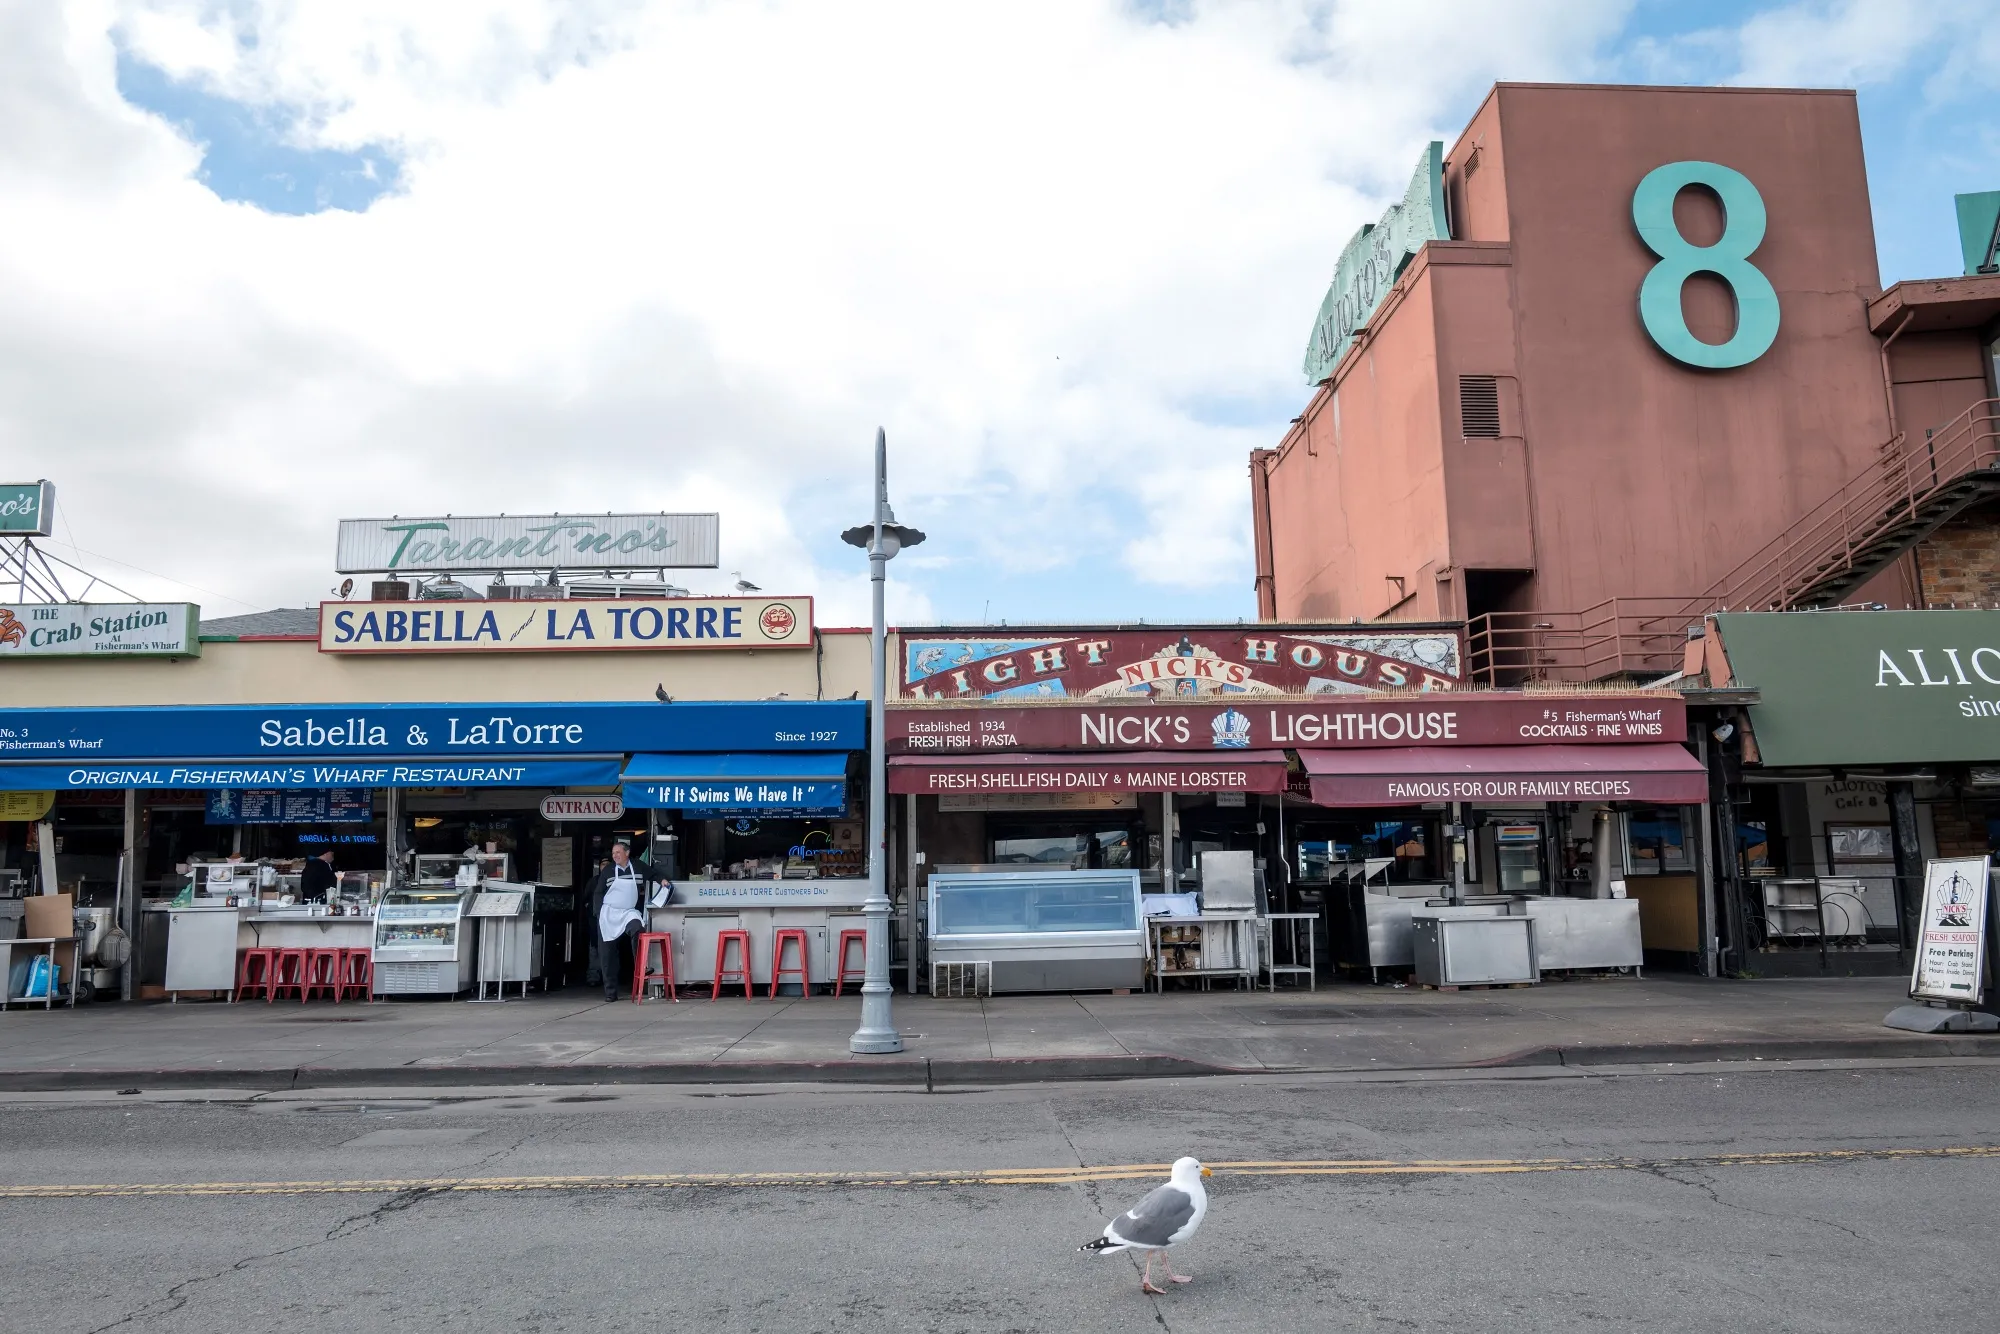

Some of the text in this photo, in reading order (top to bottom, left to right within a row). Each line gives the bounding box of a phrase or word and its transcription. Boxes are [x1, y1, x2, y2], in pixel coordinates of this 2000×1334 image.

[1633, 160, 1780, 368] 8
[0, 493, 36, 516] o's
[382, 519, 678, 568] Tarantno's
[32, 609, 58, 620] THE
[30, 609, 168, 647] Crab Station
[334, 610, 502, 643] SABELLA
[546, 608, 595, 641] LA
[607, 606, 742, 640] TORRE
[95, 642, 180, 651] Fisherman's Wharf
[1123, 657, 1246, 685] NICK'S
[1178, 681, 1192, 695] #5
[1566, 711, 1627, 722] Fisherman's
[1628, 710, 1662, 721] Wharf
[0, 728, 29, 738] No. 3
[260, 717, 583, 747] Sabella & LaTorre
[908, 721, 1005, 733] Established 1934
[1081, 710, 1458, 745] NICK'S LIGHTHOUSE
[1520, 723, 1663, 737] COCKTAILS FINE WINES
[775, 731, 838, 742] Since 1927
[908, 734, 1018, 748] FRESH FISH PASTA
[0, 739, 103, 750] Fisherman's Wharf
[68, 766, 526, 785] ORIGINAL FISHERMAN'S WHARF RESTAURANT
[929, 772, 1247, 789] FRESH SHELLFISH DAILY & MAINE LOBSTER
[674, 787, 685, 802] It
[689, 786, 730, 803] Swims
[735, 786, 753, 802] We
[758, 786, 788, 802] Have
[1388, 780, 1631, 798] FAMOUS FOR OUR FAMILY RECIPES
[545, 801, 620, 814] ENTRANCE
[699, 888, 730, 896] SABELLA
[732, 888, 737, 896] &
[739, 888, 748, 896] LA
[750, 888, 773, 896] TORRE
[1943, 904, 1967, 913] NICK'S
[1925, 933, 1978, 942] FRESH SEAFOOD
[1929, 948, 1974, 959] Free Parking
